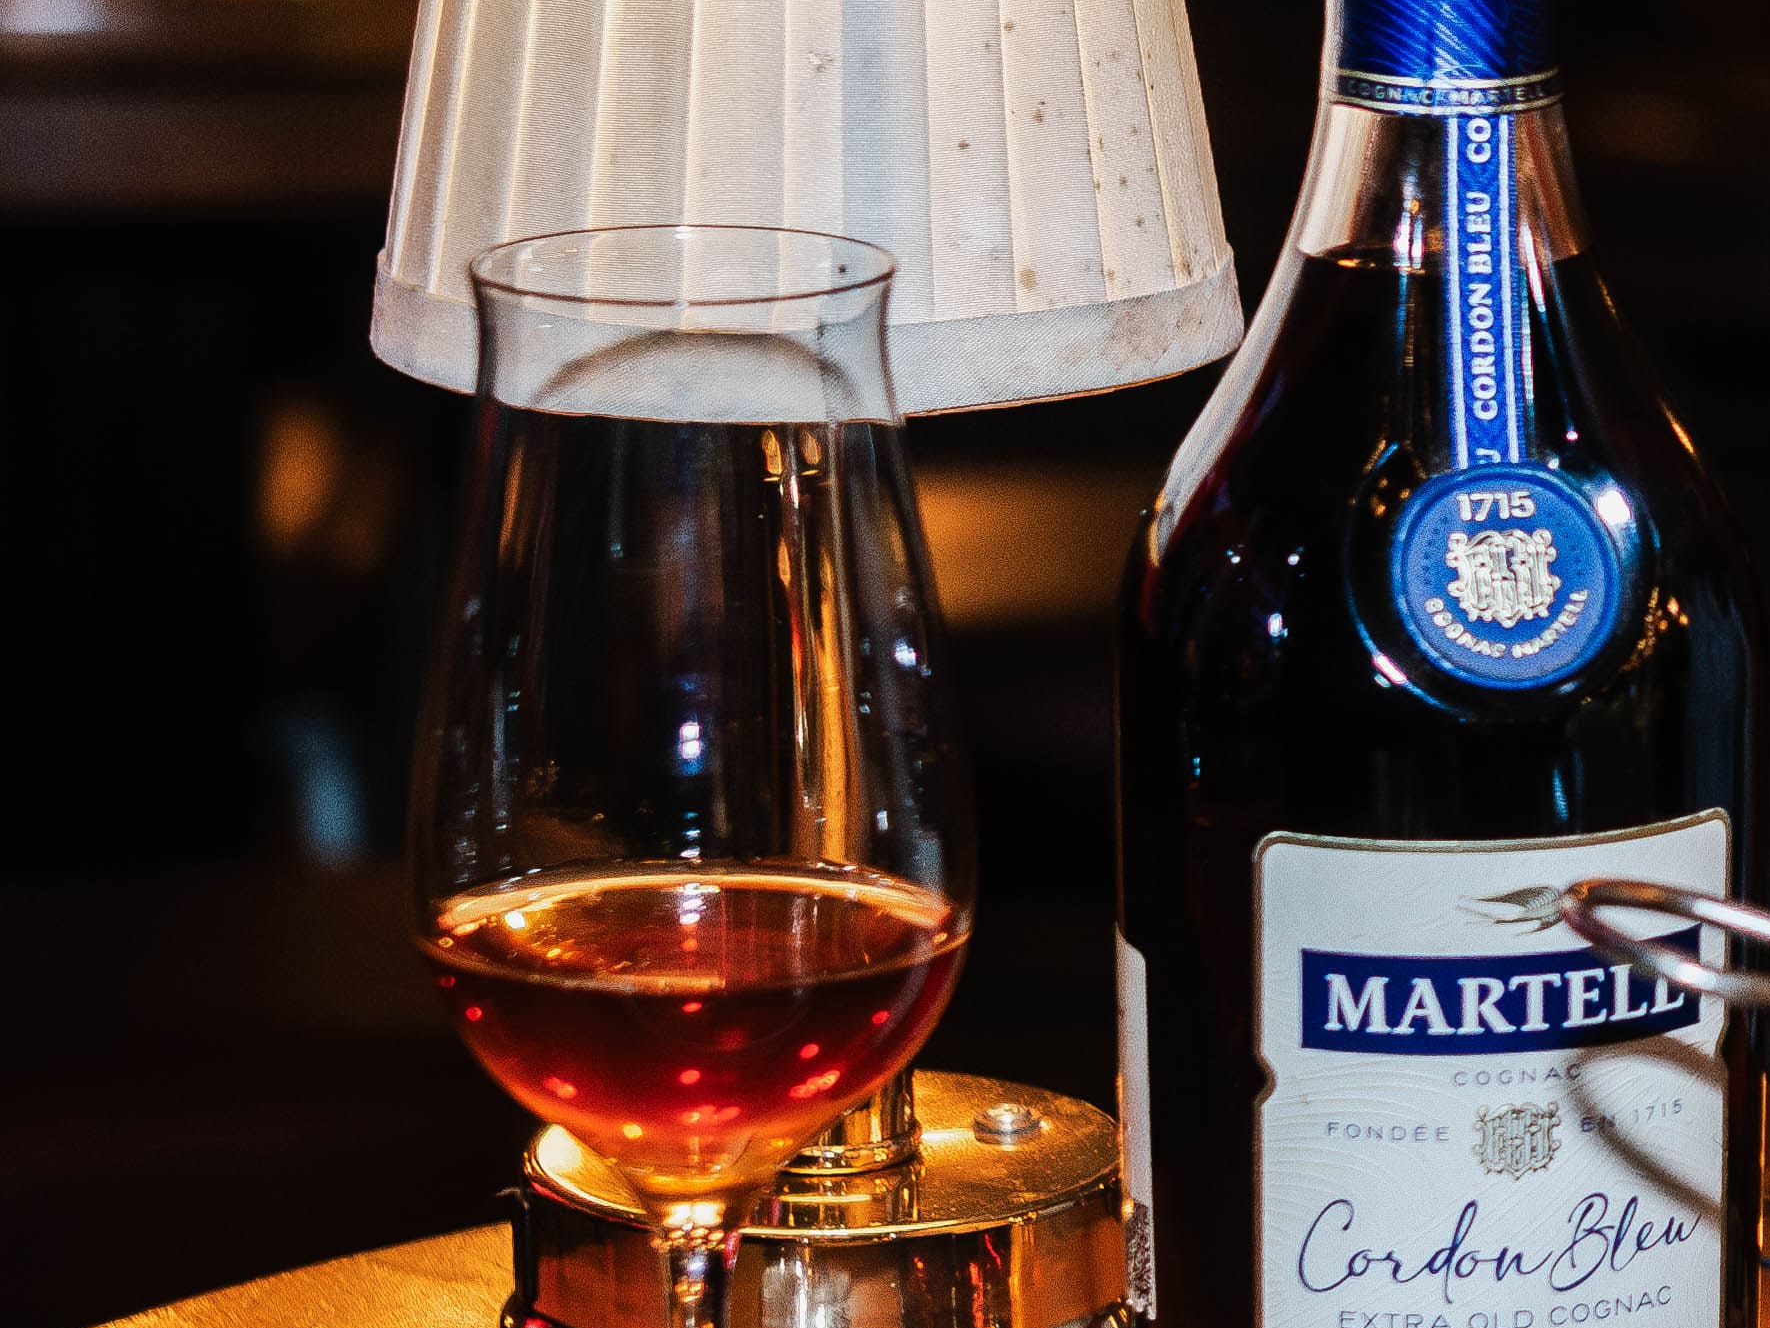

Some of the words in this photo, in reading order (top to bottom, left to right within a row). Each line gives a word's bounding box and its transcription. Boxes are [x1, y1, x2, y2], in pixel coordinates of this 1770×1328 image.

[1466, 191, 1493, 275] BLEU
[1467, 283, 1499, 421] CORDON
[1456, 491, 1536, 521] 1715
[1324, 963, 1685, 1036] MARTELL
[1453, 1062, 1582, 1087] COGNAC
[1631, 1098, 1684, 1123] 1715
[1299, 1199, 1553, 1305] Cordon
[1550, 1192, 1701, 1293] Bleu
[1548, 1285, 1673, 1327] COGNAC
